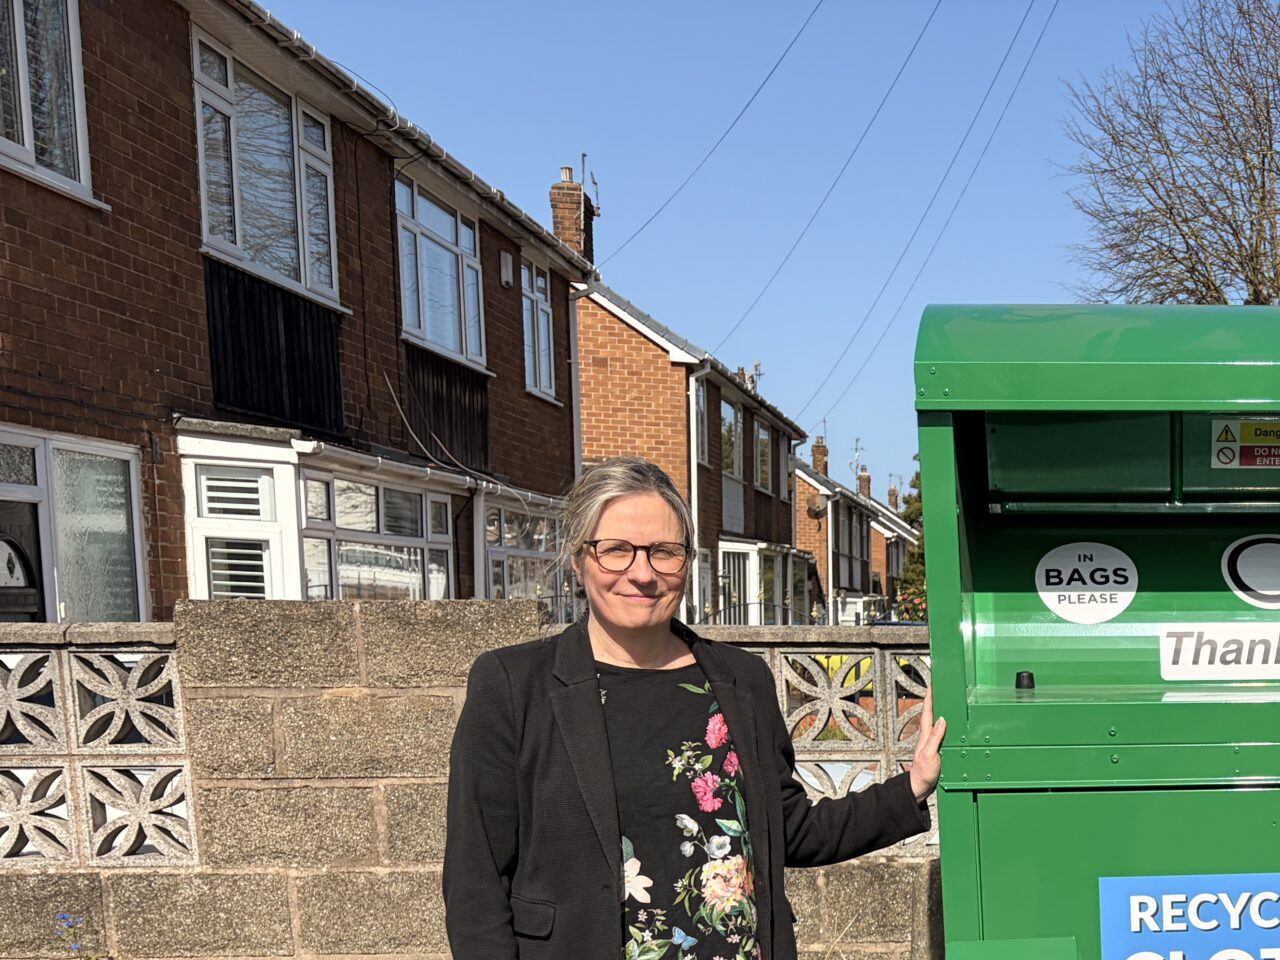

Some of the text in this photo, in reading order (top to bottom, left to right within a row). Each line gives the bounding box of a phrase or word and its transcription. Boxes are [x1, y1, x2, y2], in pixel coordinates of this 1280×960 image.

[1254, 448, 1270, 456] DO
[1077, 553, 1094, 563] IN
[1045, 567, 1130, 586] BAGS
[1058, 593, 1119, 605] PLEASE
